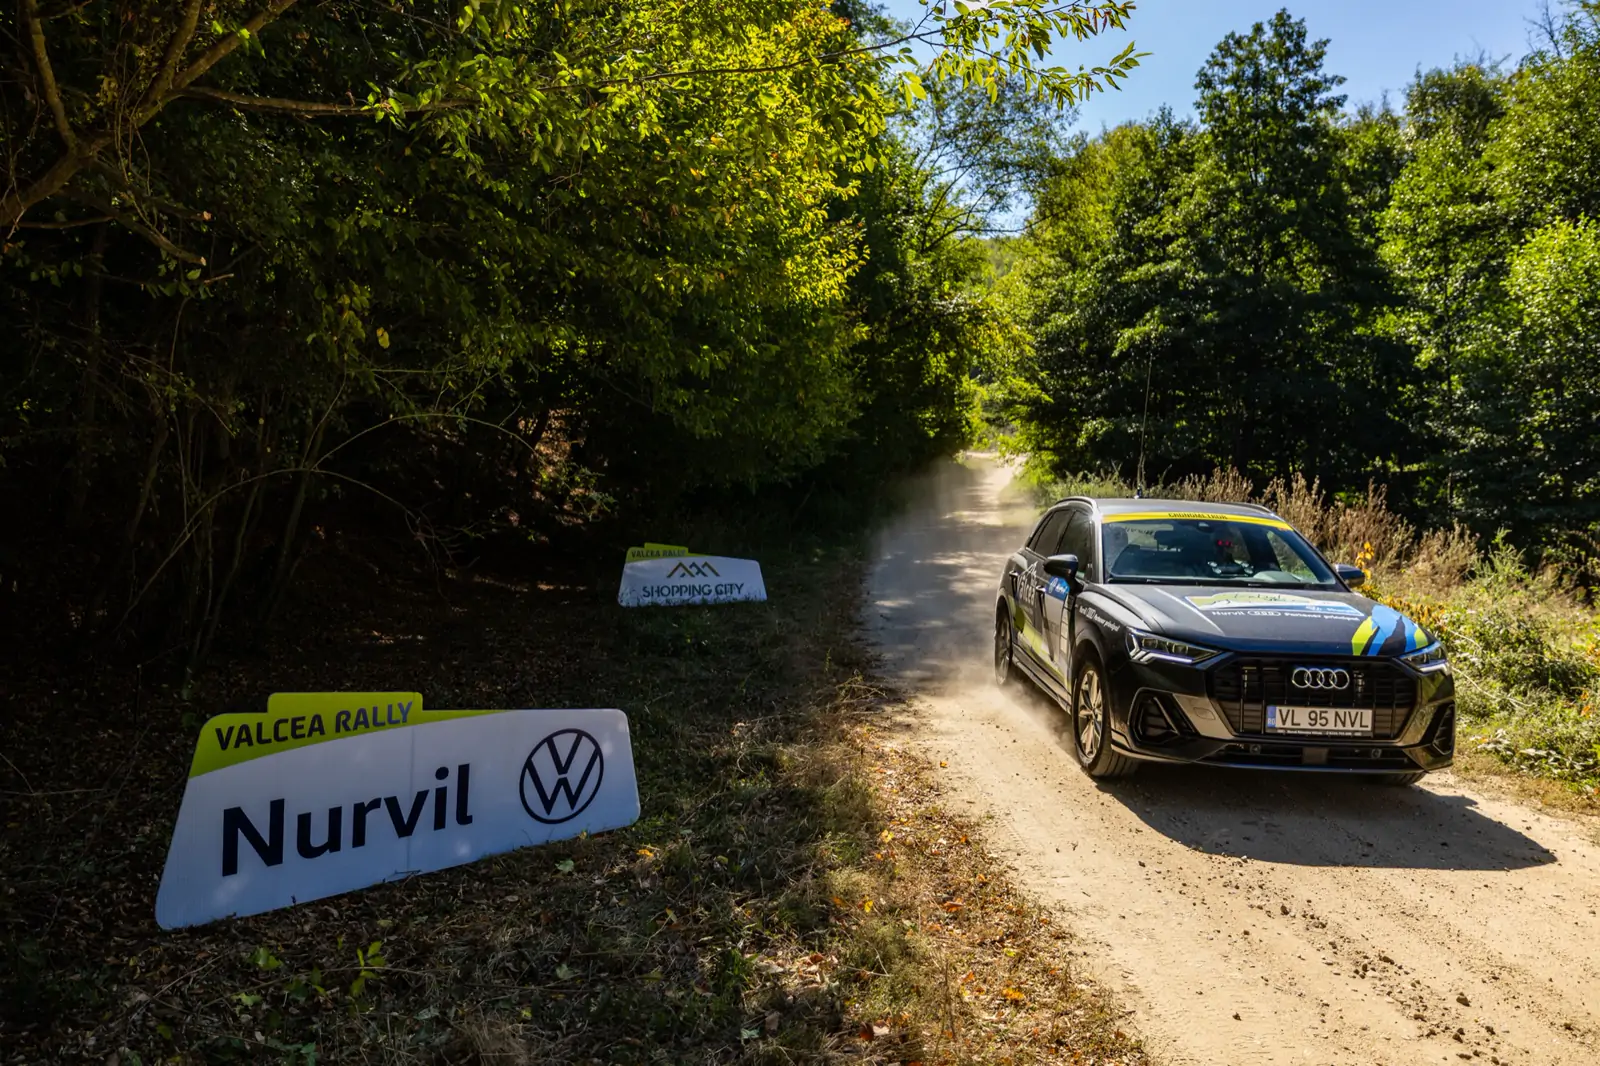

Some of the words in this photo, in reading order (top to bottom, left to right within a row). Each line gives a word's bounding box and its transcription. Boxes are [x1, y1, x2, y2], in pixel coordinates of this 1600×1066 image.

[631, 550, 661, 558] VALCEA
[663, 549, 686, 557] RALLY
[642, 584, 713, 598] SHOPPING
[714, 582, 745, 596] CITY
[216, 714, 326, 752] VALCEA
[335, 701, 413, 734] RALLY
[1267, 717, 1276, 725] RO
[1278, 709, 1302, 727] VL
[1308, 710, 1329, 727] 95
[1334, 710, 1369, 728] NVL
[222, 763, 474, 877] Nurvil
